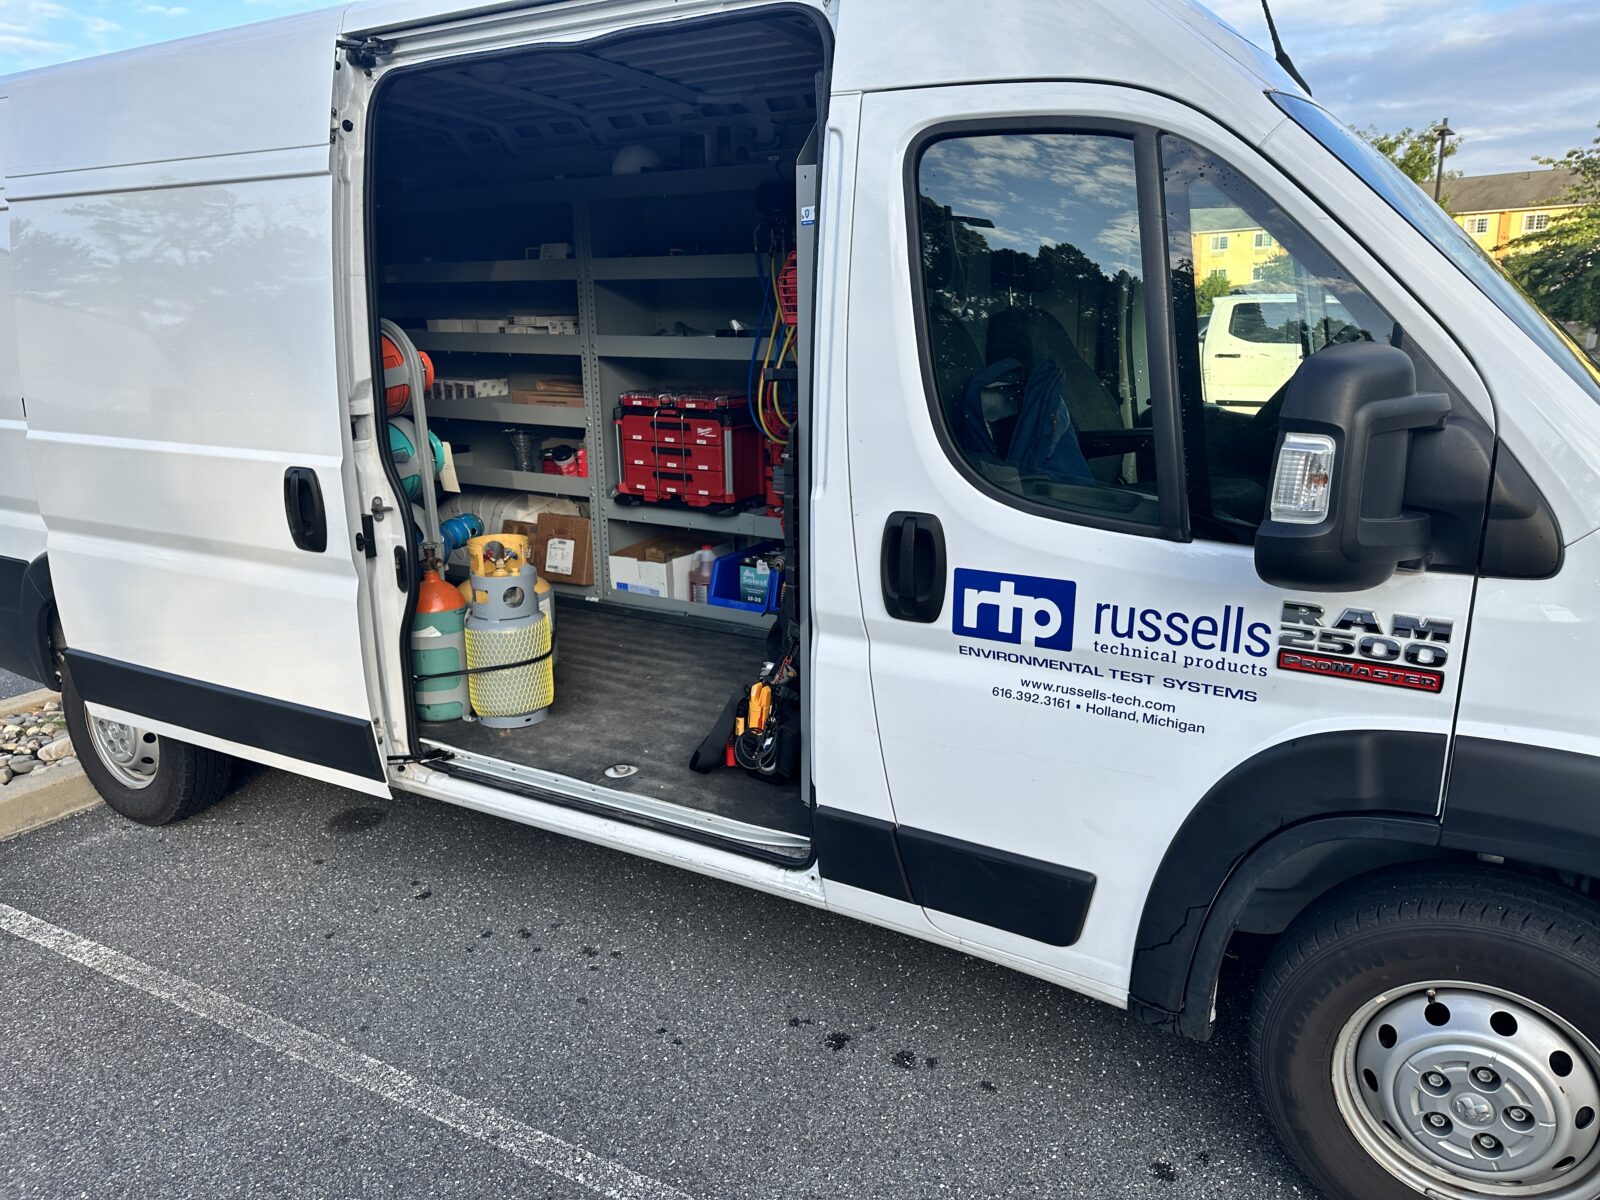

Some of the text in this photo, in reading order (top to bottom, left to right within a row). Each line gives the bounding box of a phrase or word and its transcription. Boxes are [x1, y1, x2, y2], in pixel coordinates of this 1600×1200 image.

[963, 580, 1062, 648] rtp
[1094, 603, 1272, 658] russells
[1280, 600, 1454, 643] RAM
[1093, 640, 1268, 677] technical products
[1278, 623, 1448, 668] 2500
[958, 644, 1258, 702] ENVIRONMENTAL TEST SYSTEMS
[1020, 678, 1176, 713] www.russells-tech.com
[992, 686, 1206, 735] 616.392.3161 Holland, Michigan
